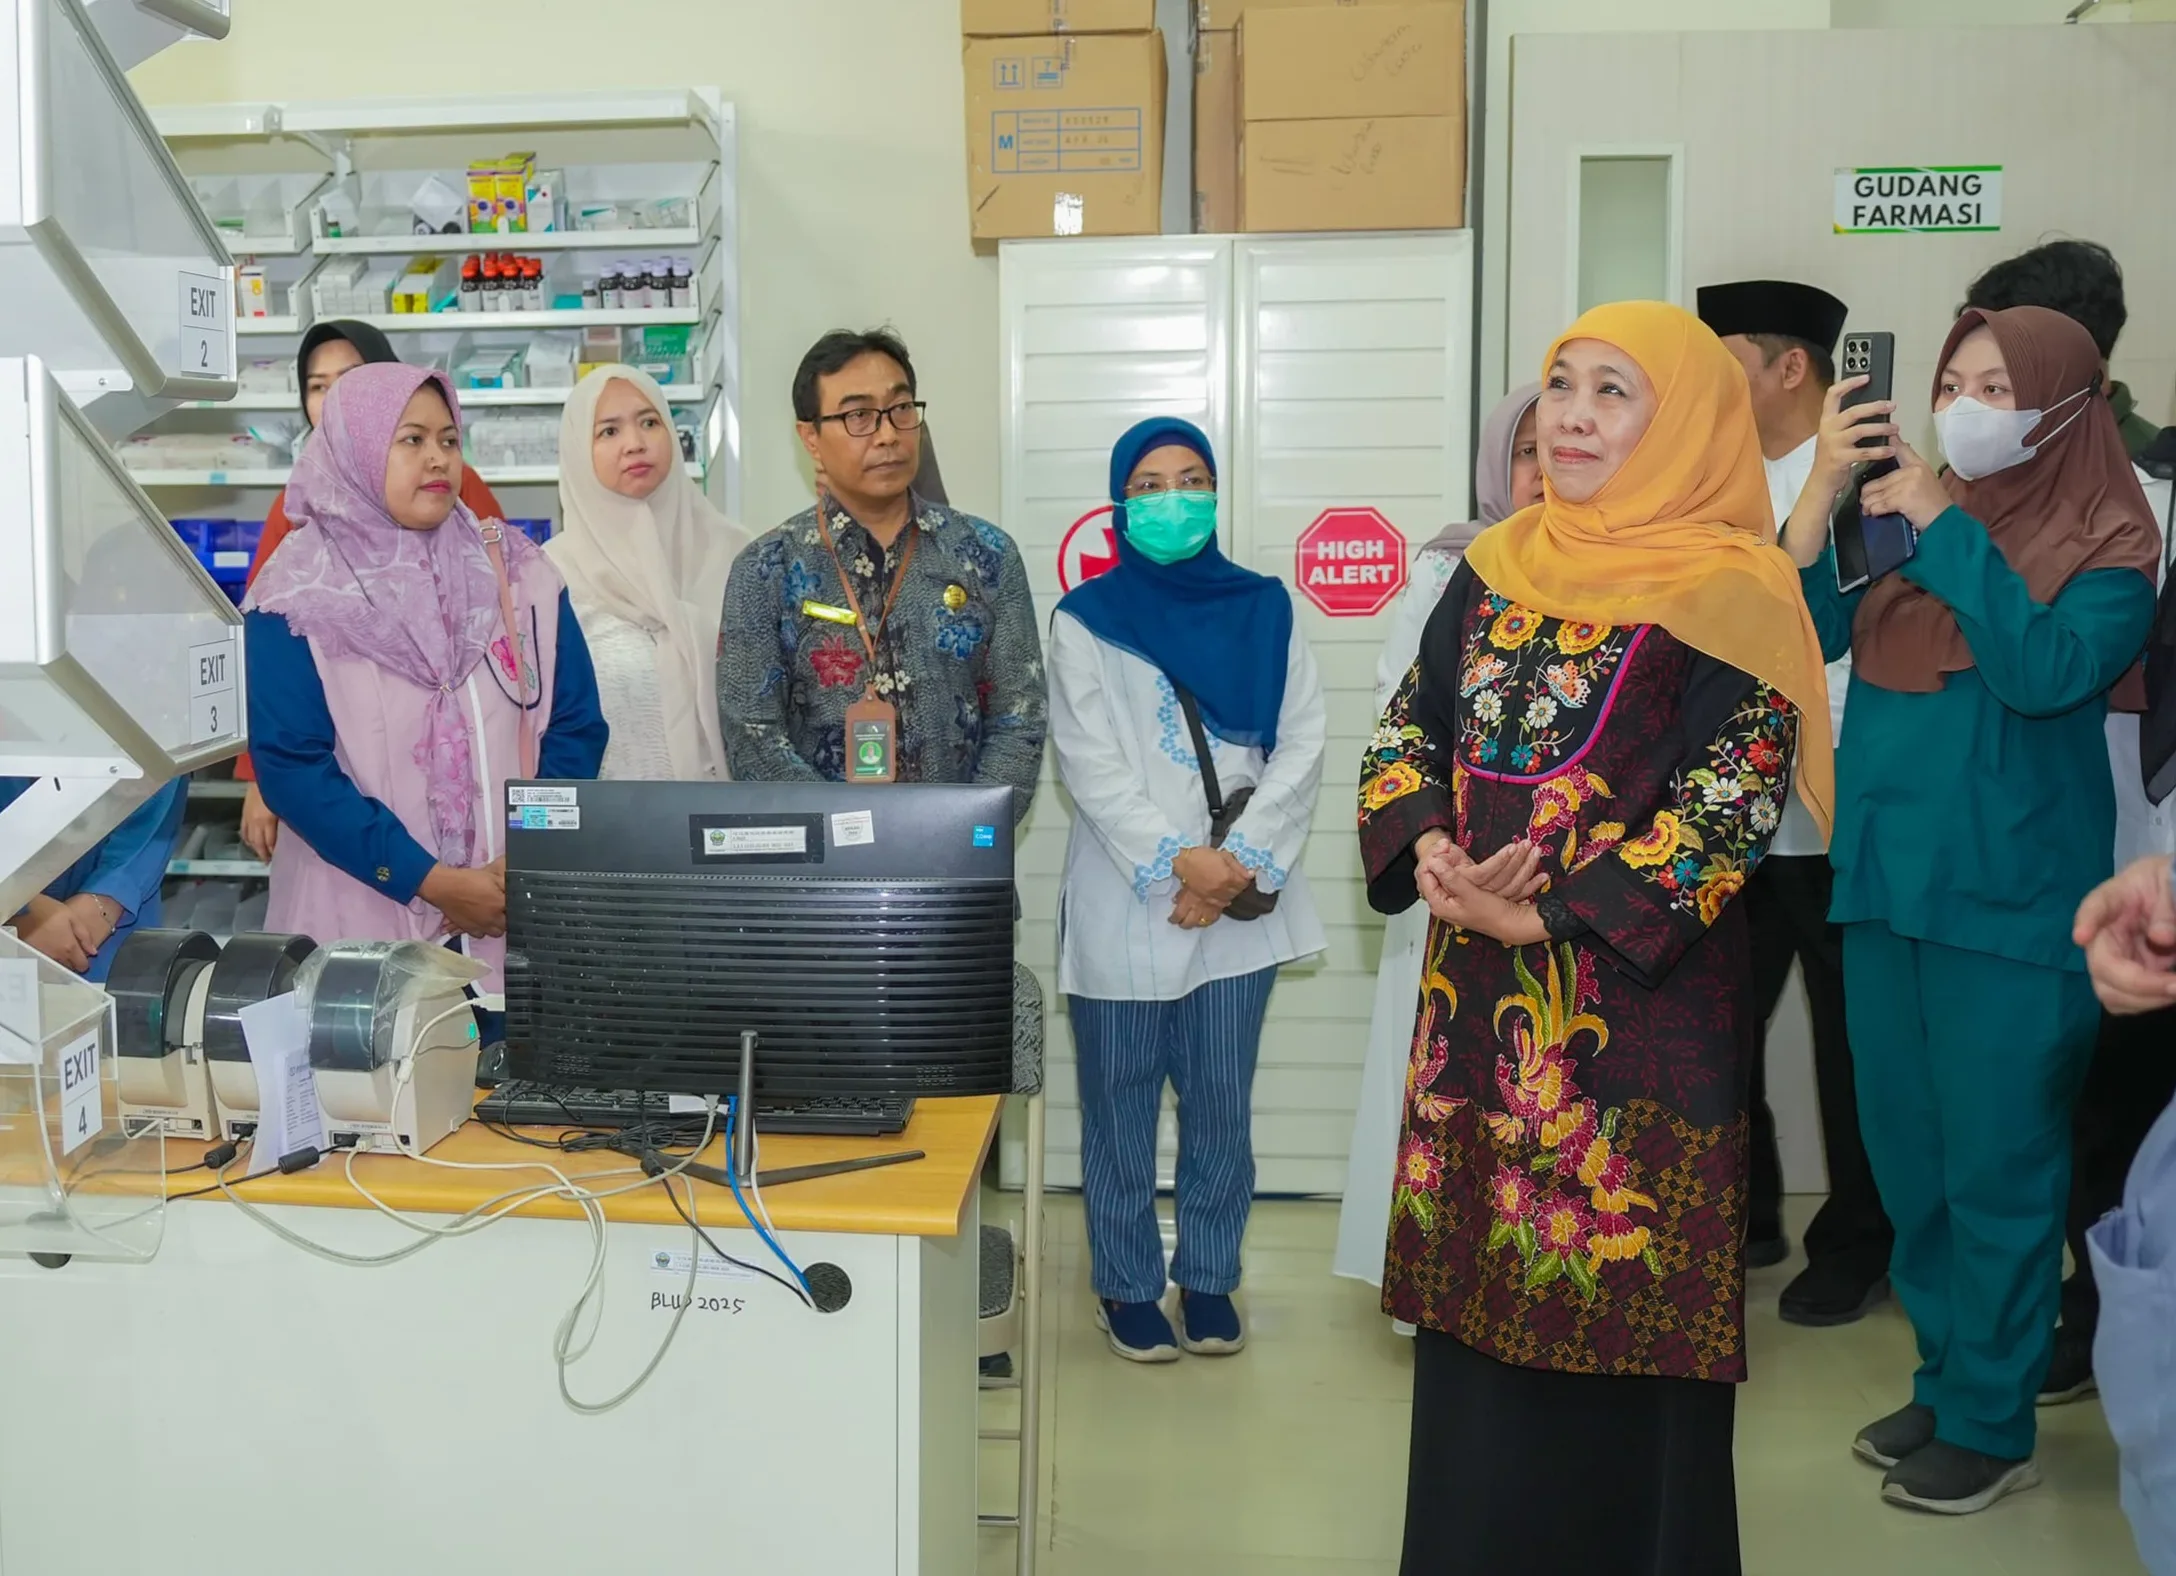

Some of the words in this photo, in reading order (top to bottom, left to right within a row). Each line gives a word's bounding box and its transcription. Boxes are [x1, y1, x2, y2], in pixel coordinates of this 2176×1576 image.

[998, 134, 1014, 150] M
[1854, 174, 1982, 198] GUDANG
[1853, 203, 1982, 226] FARMASI
[190, 287, 216, 318] EXIT
[201, 340, 208, 367] 2
[1317, 540, 1384, 560] HIGH
[1308, 564, 1395, 585] ALERT
[200, 654, 225, 685] EXIT
[210, 705, 218, 733] 3
[64, 1042, 96, 1090] EXIT
[79, 1105, 87, 1135] 4
[697, 1297, 745, 1315] 2025
